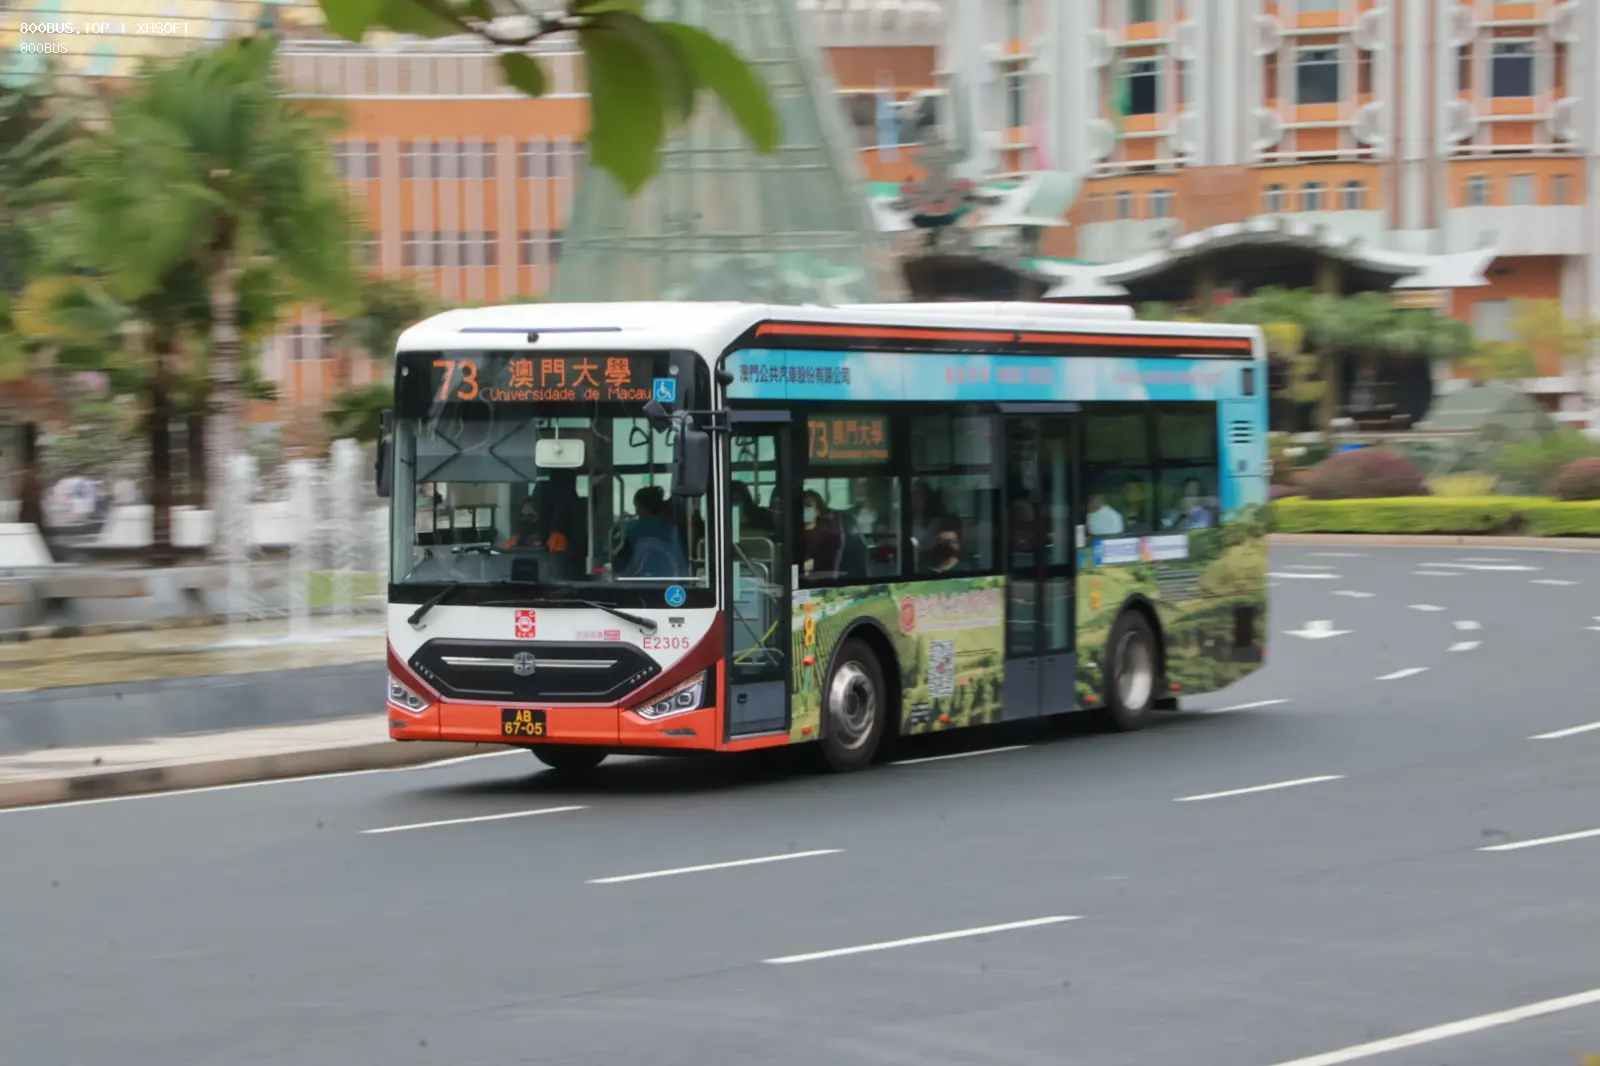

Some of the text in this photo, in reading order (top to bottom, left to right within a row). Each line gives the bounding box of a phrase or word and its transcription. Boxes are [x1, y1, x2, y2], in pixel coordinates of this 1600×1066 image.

[432, 359, 479, 400] 73
[508, 357, 632, 387] 澳門大學
[739, 363, 852, 386] 澳門公共汽車股份有限公司
[489, 387, 652, 401] Universidade de Macau
[807, 421, 828, 458] 73
[643, 637, 690, 649] E2305
[515, 710, 532, 722] AB
[504, 722, 543, 736] 67-05
